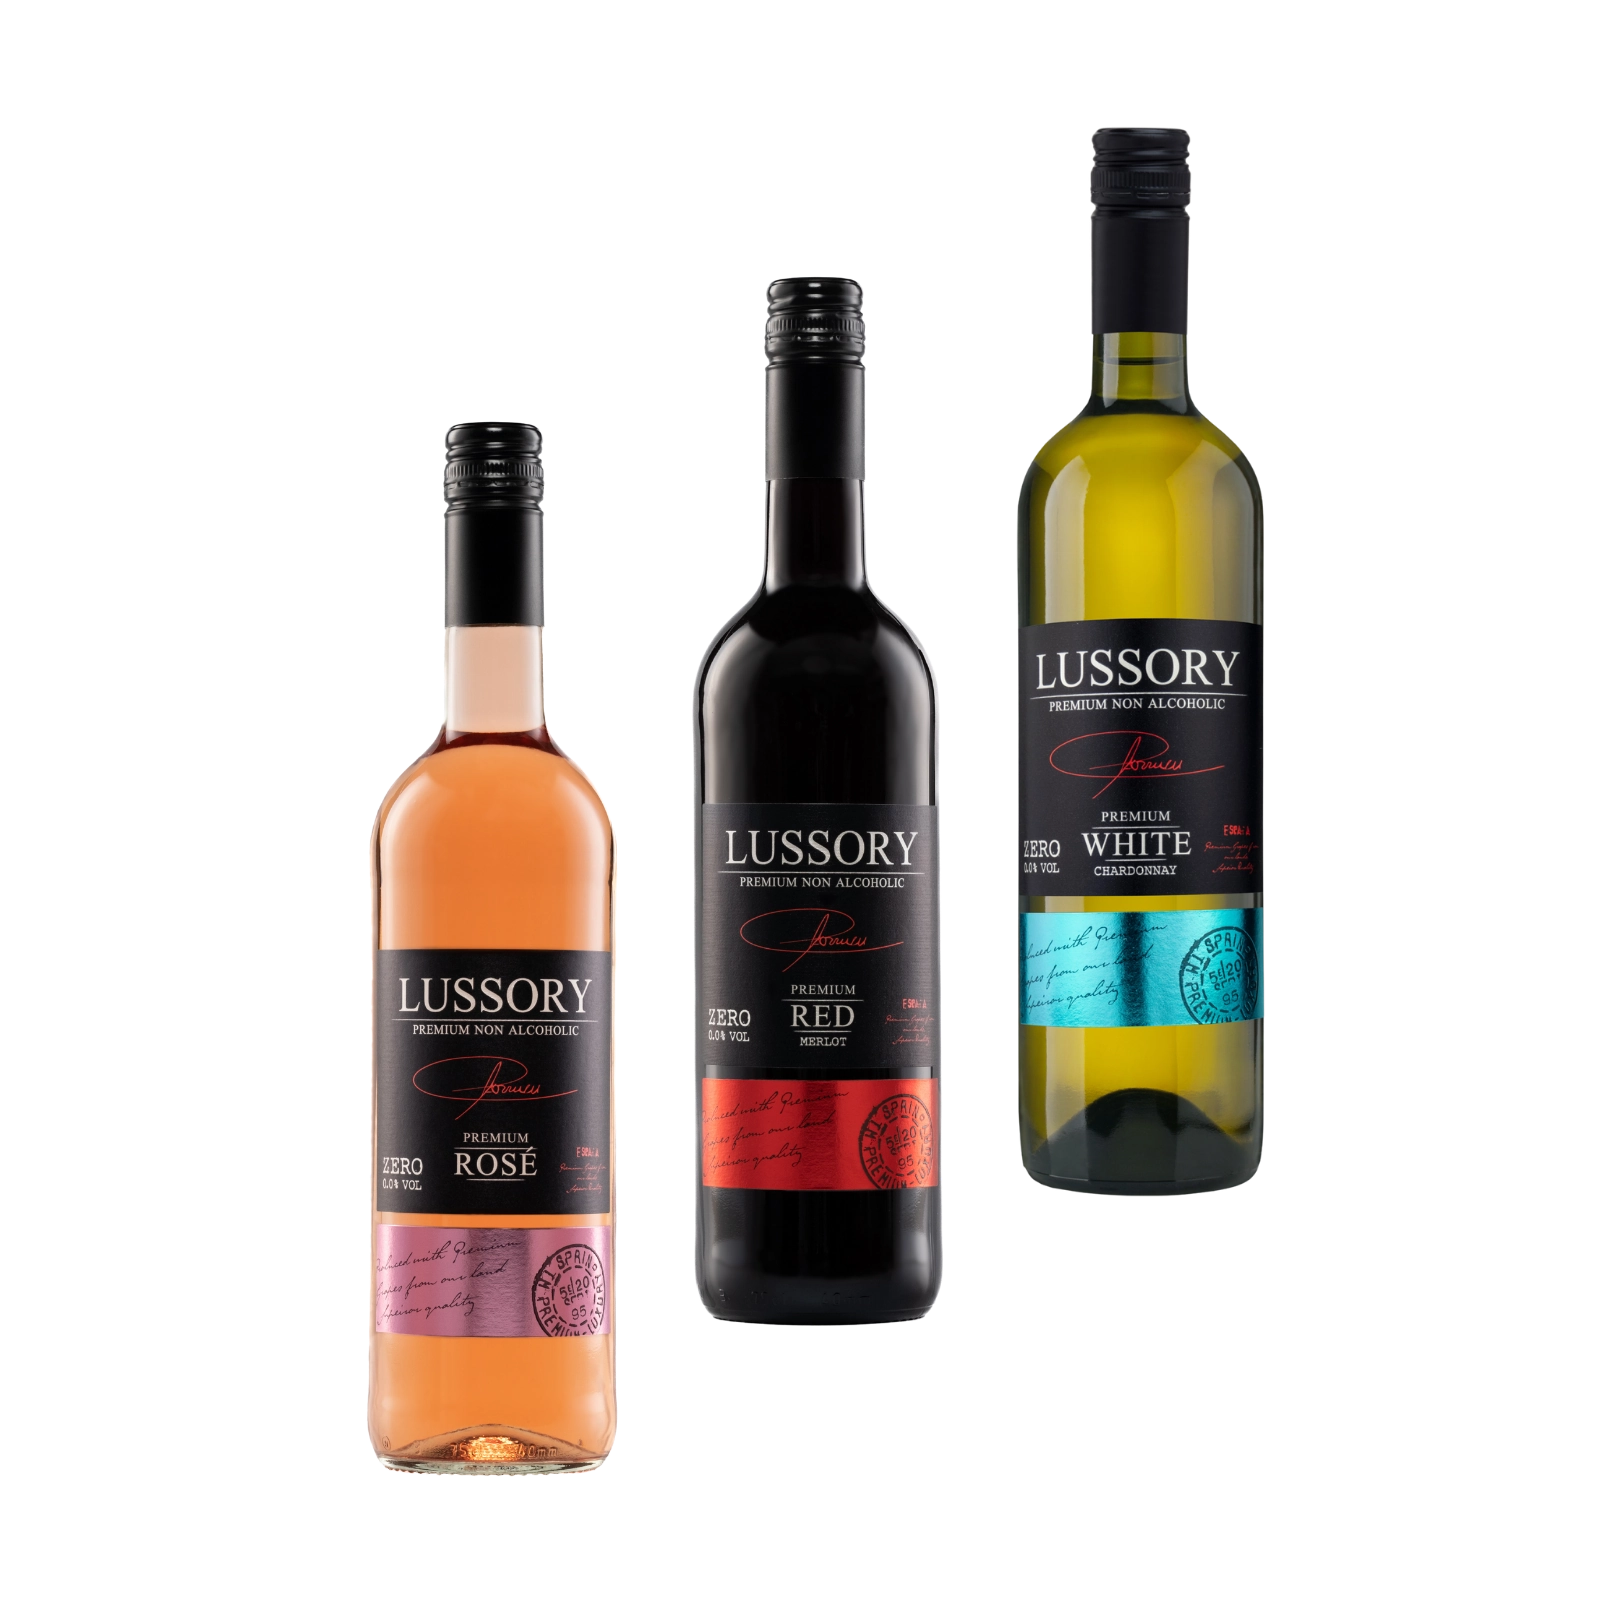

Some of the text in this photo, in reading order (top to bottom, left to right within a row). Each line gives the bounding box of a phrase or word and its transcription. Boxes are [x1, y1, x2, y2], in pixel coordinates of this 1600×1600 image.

[1036, 648, 1240, 690] LUSSORY
[1049, 698, 1226, 712] PREMIUM NON ALCOHOLIC
[1101, 811, 1171, 822] PREMIUM
[724, 829, 919, 866] LUSSORY
[1023, 839, 1061, 858] ZERO
[1081, 832, 1192, 857] WHITE
[1023, 862, 1060, 873] 0.0% VOL
[1094, 865, 1178, 876] CHARDONNAY
[739, 877, 905, 888] PREMIUM NON ALCOHOLIC
[1053, 925, 1093, 951] with
[1046, 964, 1080, 990] from
[398, 977, 593, 1013] LUSSORY
[790, 984, 856, 995] PREMIUM
[1066, 979, 1122, 1010] quality
[1222, 989, 1239, 1005] 95
[708, 1008, 751, 1027] ZERO
[790, 1004, 855, 1028] RED
[412, 1024, 580, 1036] PREMIUM NON ALCOHOLIC
[708, 1029, 750, 1042] 0.0% VOL
[799, 1036, 847, 1047] MERLOT
[740, 1091, 778, 1115] with
[780, 1090, 849, 1114] Premium
[463, 1132, 529, 1143] PREMIUM
[732, 1127, 765, 1150] from
[382, 1156, 423, 1175] ZERO
[453, 1147, 538, 1176] ROSÉ
[752, 1142, 806, 1170] quality
[898, 1155, 914, 1170] 95
[382, 1178, 422, 1190] 0.0% VOL
[413, 1240, 451, 1263] with
[453, 1239, 522, 1263] Premium
[405, 1276, 437, 1300] from
[425, 1292, 480, 1319] quality
[572, 1305, 586, 1320] 95
